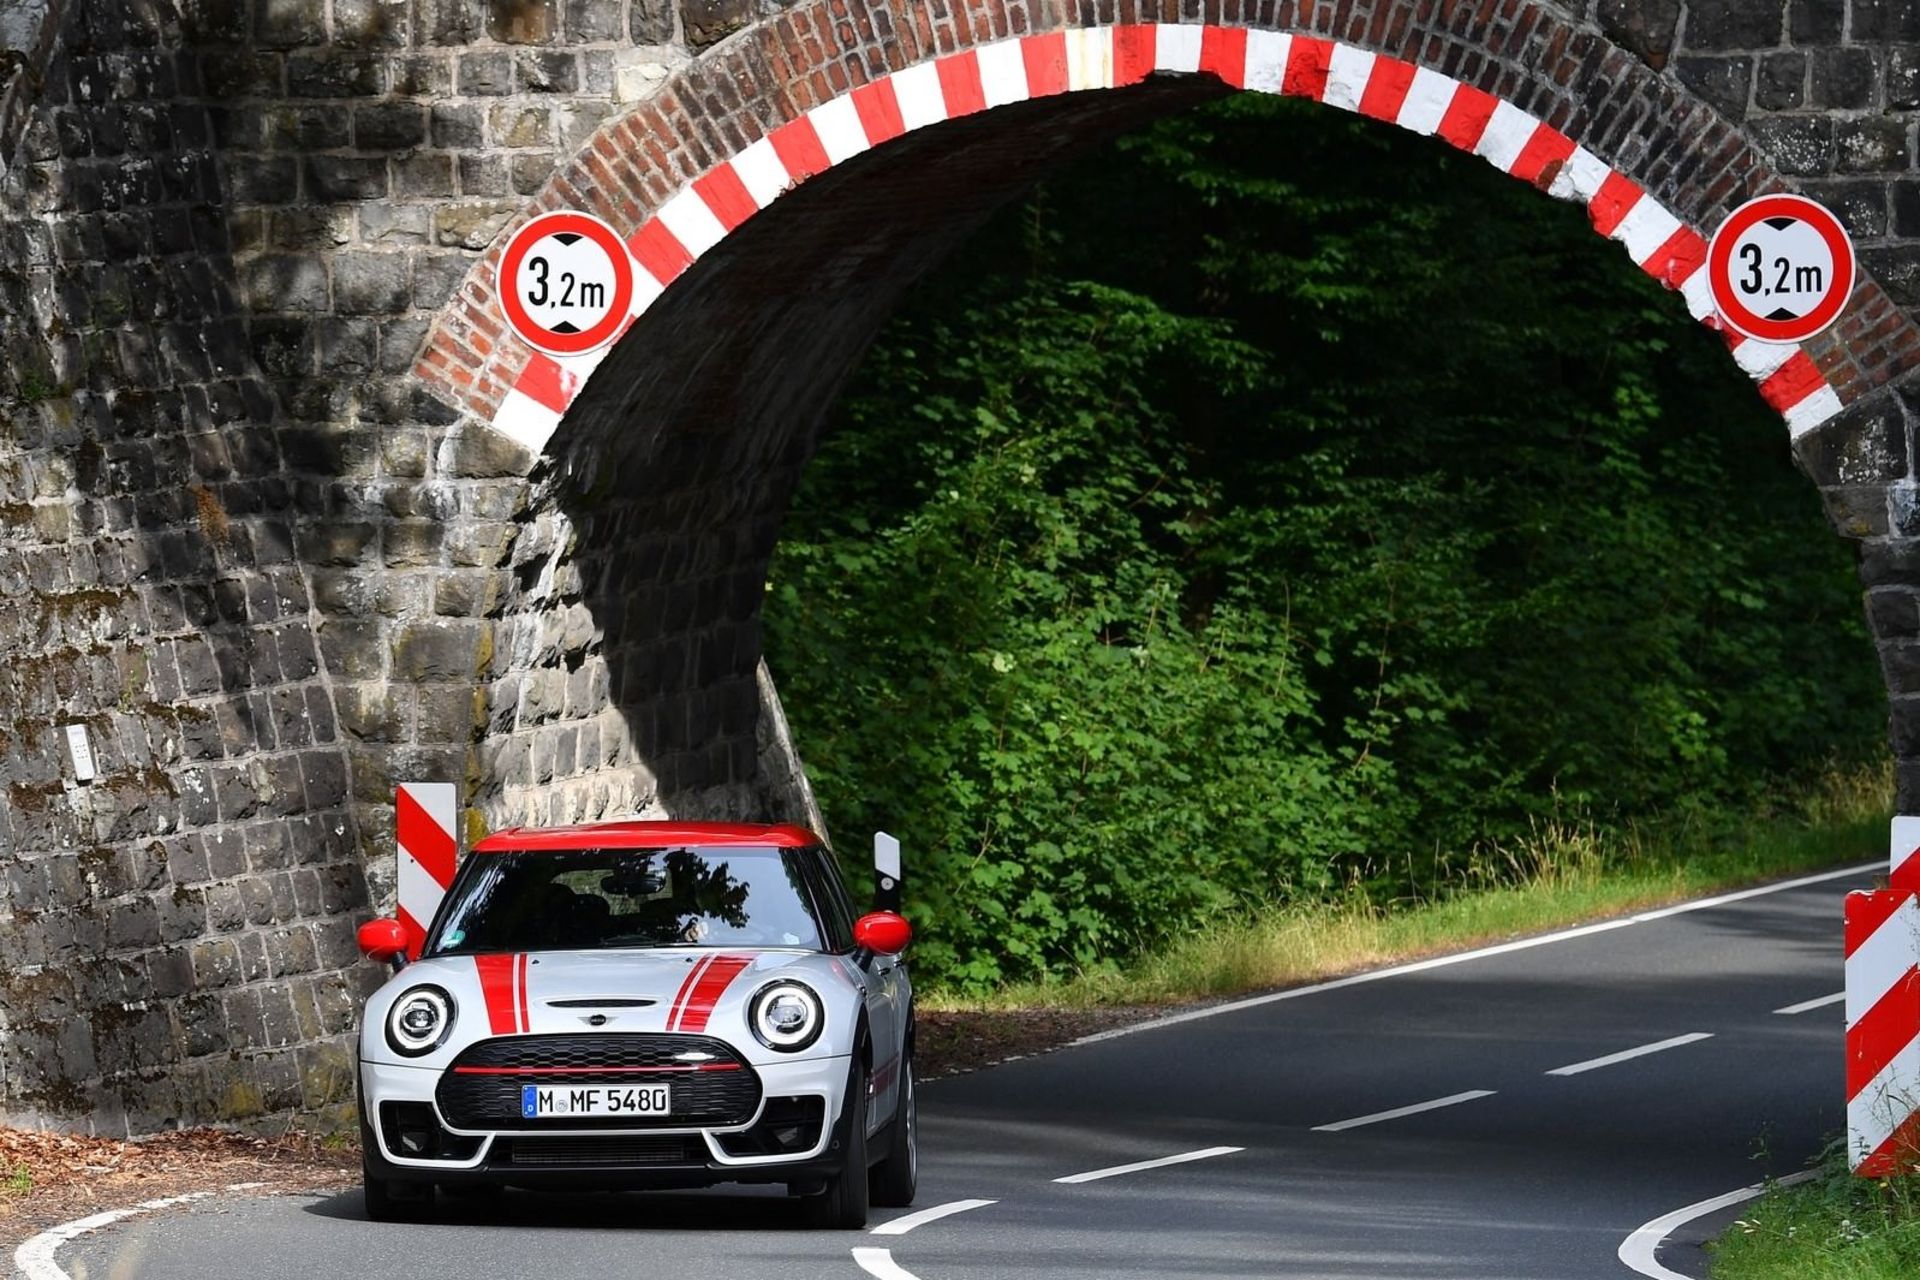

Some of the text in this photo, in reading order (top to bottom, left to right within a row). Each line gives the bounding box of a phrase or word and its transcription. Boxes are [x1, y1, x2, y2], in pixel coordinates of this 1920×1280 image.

[539, 1089, 666, 1112] M MF 5480
